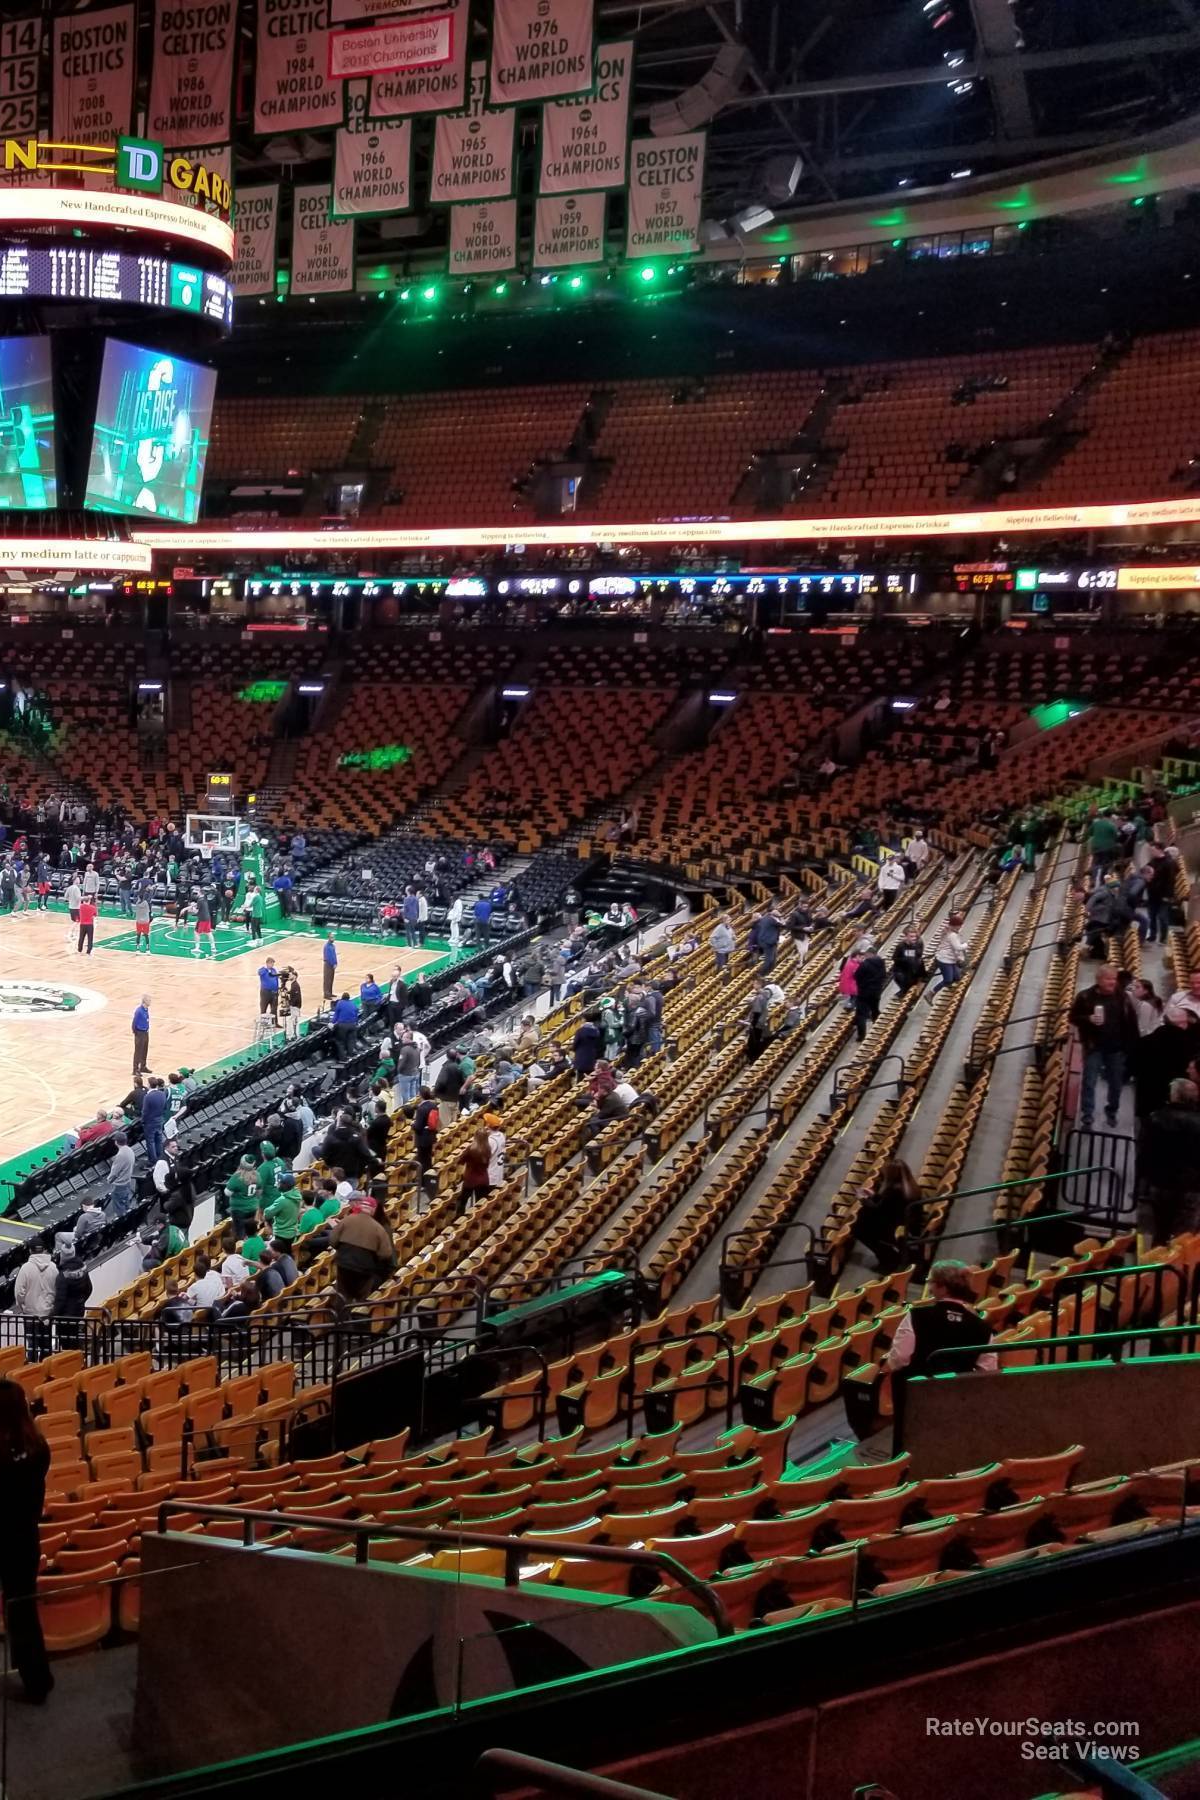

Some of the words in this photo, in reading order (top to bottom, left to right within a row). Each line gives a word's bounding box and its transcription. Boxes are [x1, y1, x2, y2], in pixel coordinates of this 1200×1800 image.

[161, 4, 231, 32] BOSTON
[267, 10, 328, 38] CELTIC
[6, 21, 37, 54] 14
[60, 20, 128, 54] BOSTON
[527, 19, 559, 40] 1976
[162, 29, 227, 56] CELTICS
[342, 37, 381, 51] Boston
[384, 28, 440, 46] University
[373, 45, 437, 64] Champions
[515, 38, 569, 62] WORLD
[62, 48, 125, 78] CELTICS
[286, 58, 315, 74] 1984
[499, 55, 585, 85] CHAMPIONS
[5, 60, 37, 92] 15
[178, 77, 205, 92] 1986
[277, 75, 323, 95] WORLD
[377, 74, 459, 98] CHAMPIONS
[79, 95, 105, 112] 2008
[169, 95, 212, 112] WORLD
[260, 92, 337, 116] CHAMPIONS
[0, 99, 34, 131] 25
[73, 112, 113, 131] WORLD
[154, 112, 225, 131] CHAMPIONS
[571, 125, 598, 140] 1964
[461, 137, 486, 152] 1965
[562, 141, 607, 158] WORLD
[122, 145, 159, 181] TD
[361, 151, 385, 166] 1966
[452, 153, 494, 169] WORLD
[636, 146, 699, 169] BOSTON
[353, 167, 392, 183] WORLD
[546, 157, 620, 178] CHAMPIONS
[437, 168, 507, 187] CHAMPIONS
[638, 166, 695, 188] CELTICS
[339, 182, 405, 200] CHAMPIONS
[60, 200, 83, 209] New
[84, 201, 144, 216] Handcrafted
[145, 209, 178, 224] Espresso
[179, 216, 201, 230] Drinks
[233, 197, 273, 215] OSTON
[655, 201, 678, 215] 1957
[233, 214, 271, 232] ELTICS
[472, 221, 494, 234] 1960
[559, 212, 581, 225] 1959
[645, 215, 684, 230] WORLD
[465, 234, 501, 248] WORLD
[552, 225, 589, 240] WORLD
[632, 228, 696, 246] CHAMPIONS
[237, 247, 256, 259] 1962
[314, 243, 333, 255] 1961
[454, 246, 512, 263] CHAMPIONS
[538, 238, 600, 255] CHAMPIONS
[307, 257, 339, 269] WORLD
[295, 269, 348, 284] CHAMPIONS
[181, 284, 193, 306] 0
[135, 389, 151, 433] US
[152, 389, 178, 430] RISE
[21, 548, 72, 560] medium
[75, 549, 98, 561] latte
[100, 552, 110, 560] or
[1078, 570, 1118, 588] 6:32
